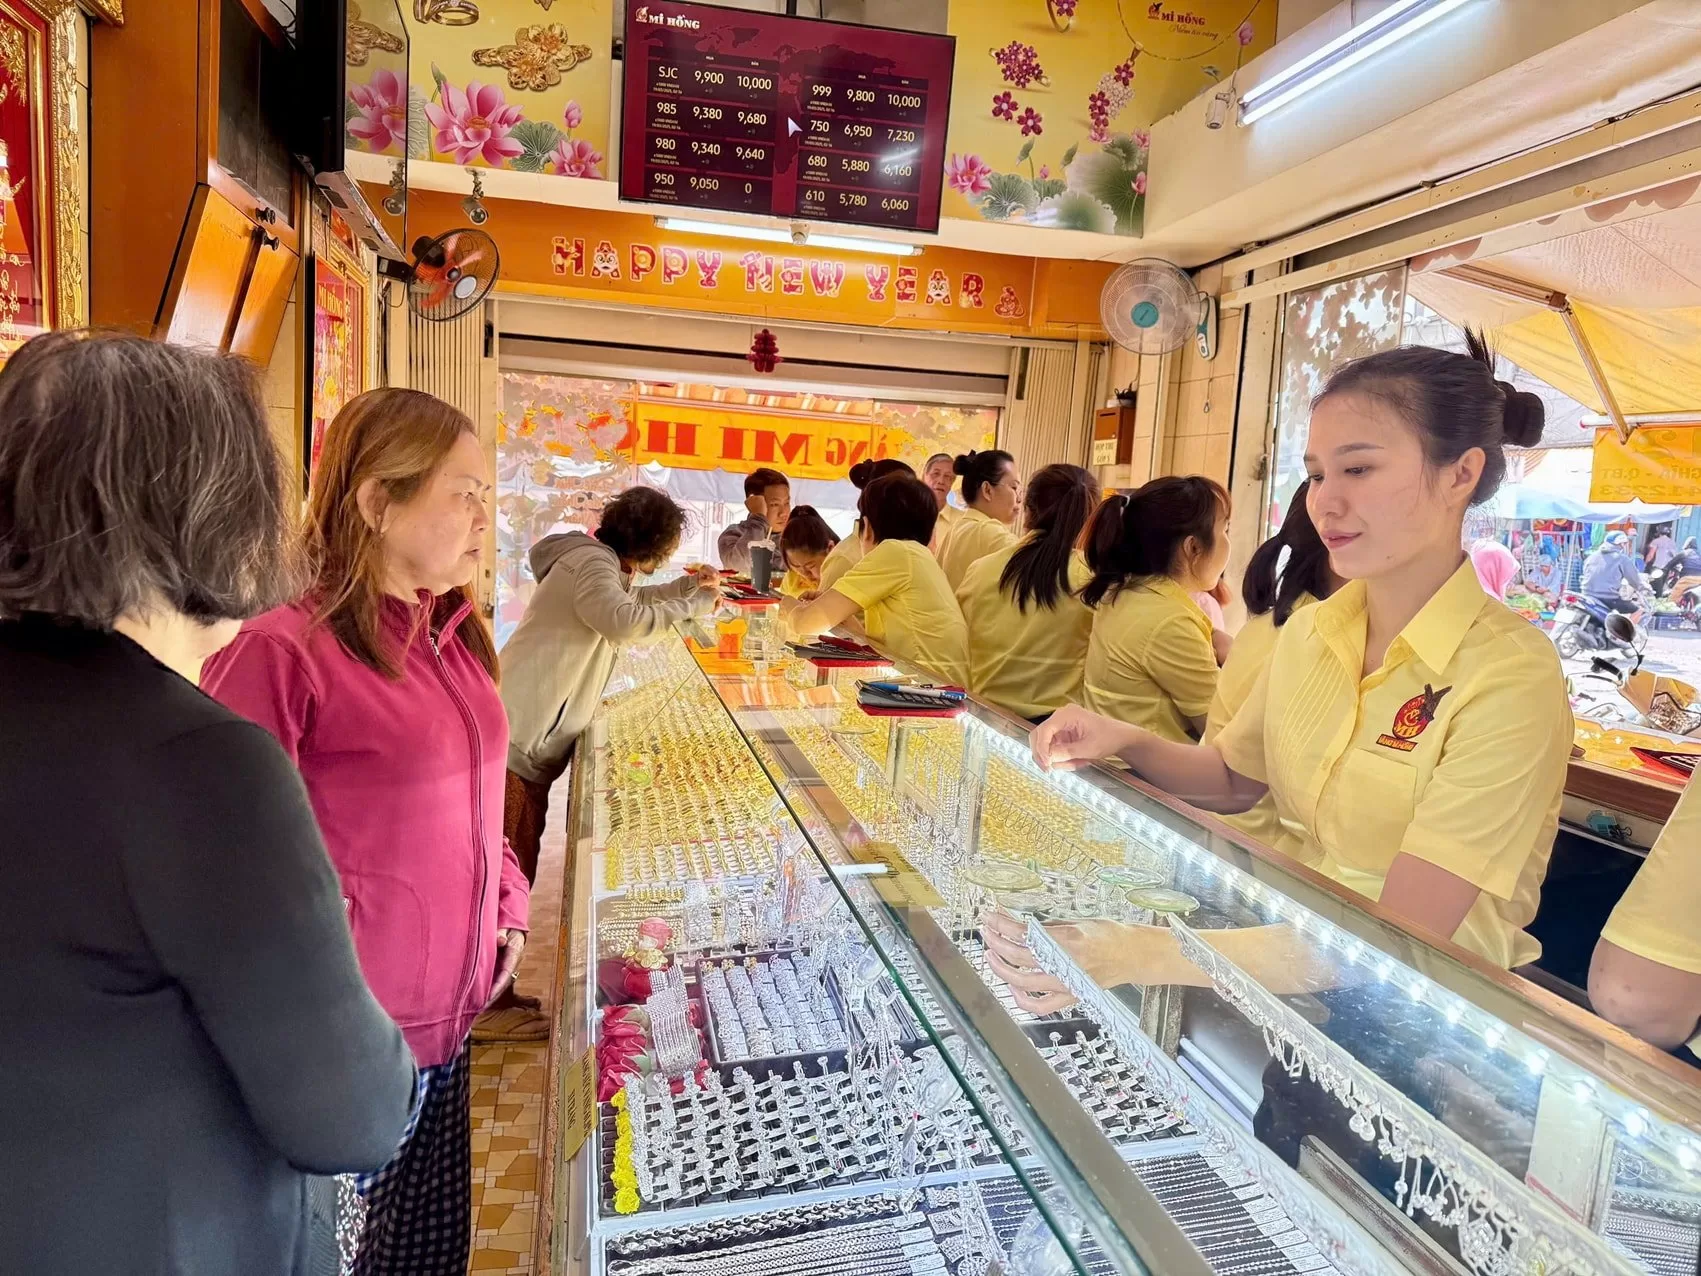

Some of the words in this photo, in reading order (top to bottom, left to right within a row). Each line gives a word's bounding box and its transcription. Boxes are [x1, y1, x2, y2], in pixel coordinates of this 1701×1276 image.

[658, 66, 678, 79] SJC
[694, 70, 724, 84] 9,900
[737, 75, 772, 90] 10,000
[812, 85, 832, 97] 999
[847, 89, 875, 102] 9,800
[887, 94, 921, 108] 10,000
[656, 102, 677, 114] 985
[693, 106, 722, 120] 9,380
[737, 111, 767, 125] 9,680
[810, 120, 830, 132] 750
[844, 124, 873, 138] 6,950
[887, 129, 915, 143] 7,230
[655, 138, 676, 150] 980
[691, 142, 721, 155] 9,340
[736, 147, 765, 160] 9,640
[807, 155, 827, 167] 680
[841, 159, 870, 172] 5,880
[884, 164, 912, 177] 6,160
[654, 173, 674, 185] 950
[690, 177, 719, 190] 9,050
[744, 183, 752, 194] 0
[805, 190, 825, 201] 610
[839, 193, 867, 206] 5,780
[881, 198, 909, 211] 6,060
[551, 235, 723, 288] HAPPY
[738, 250, 846, 298] NEW
[865, 263, 984, 308] YEAR
